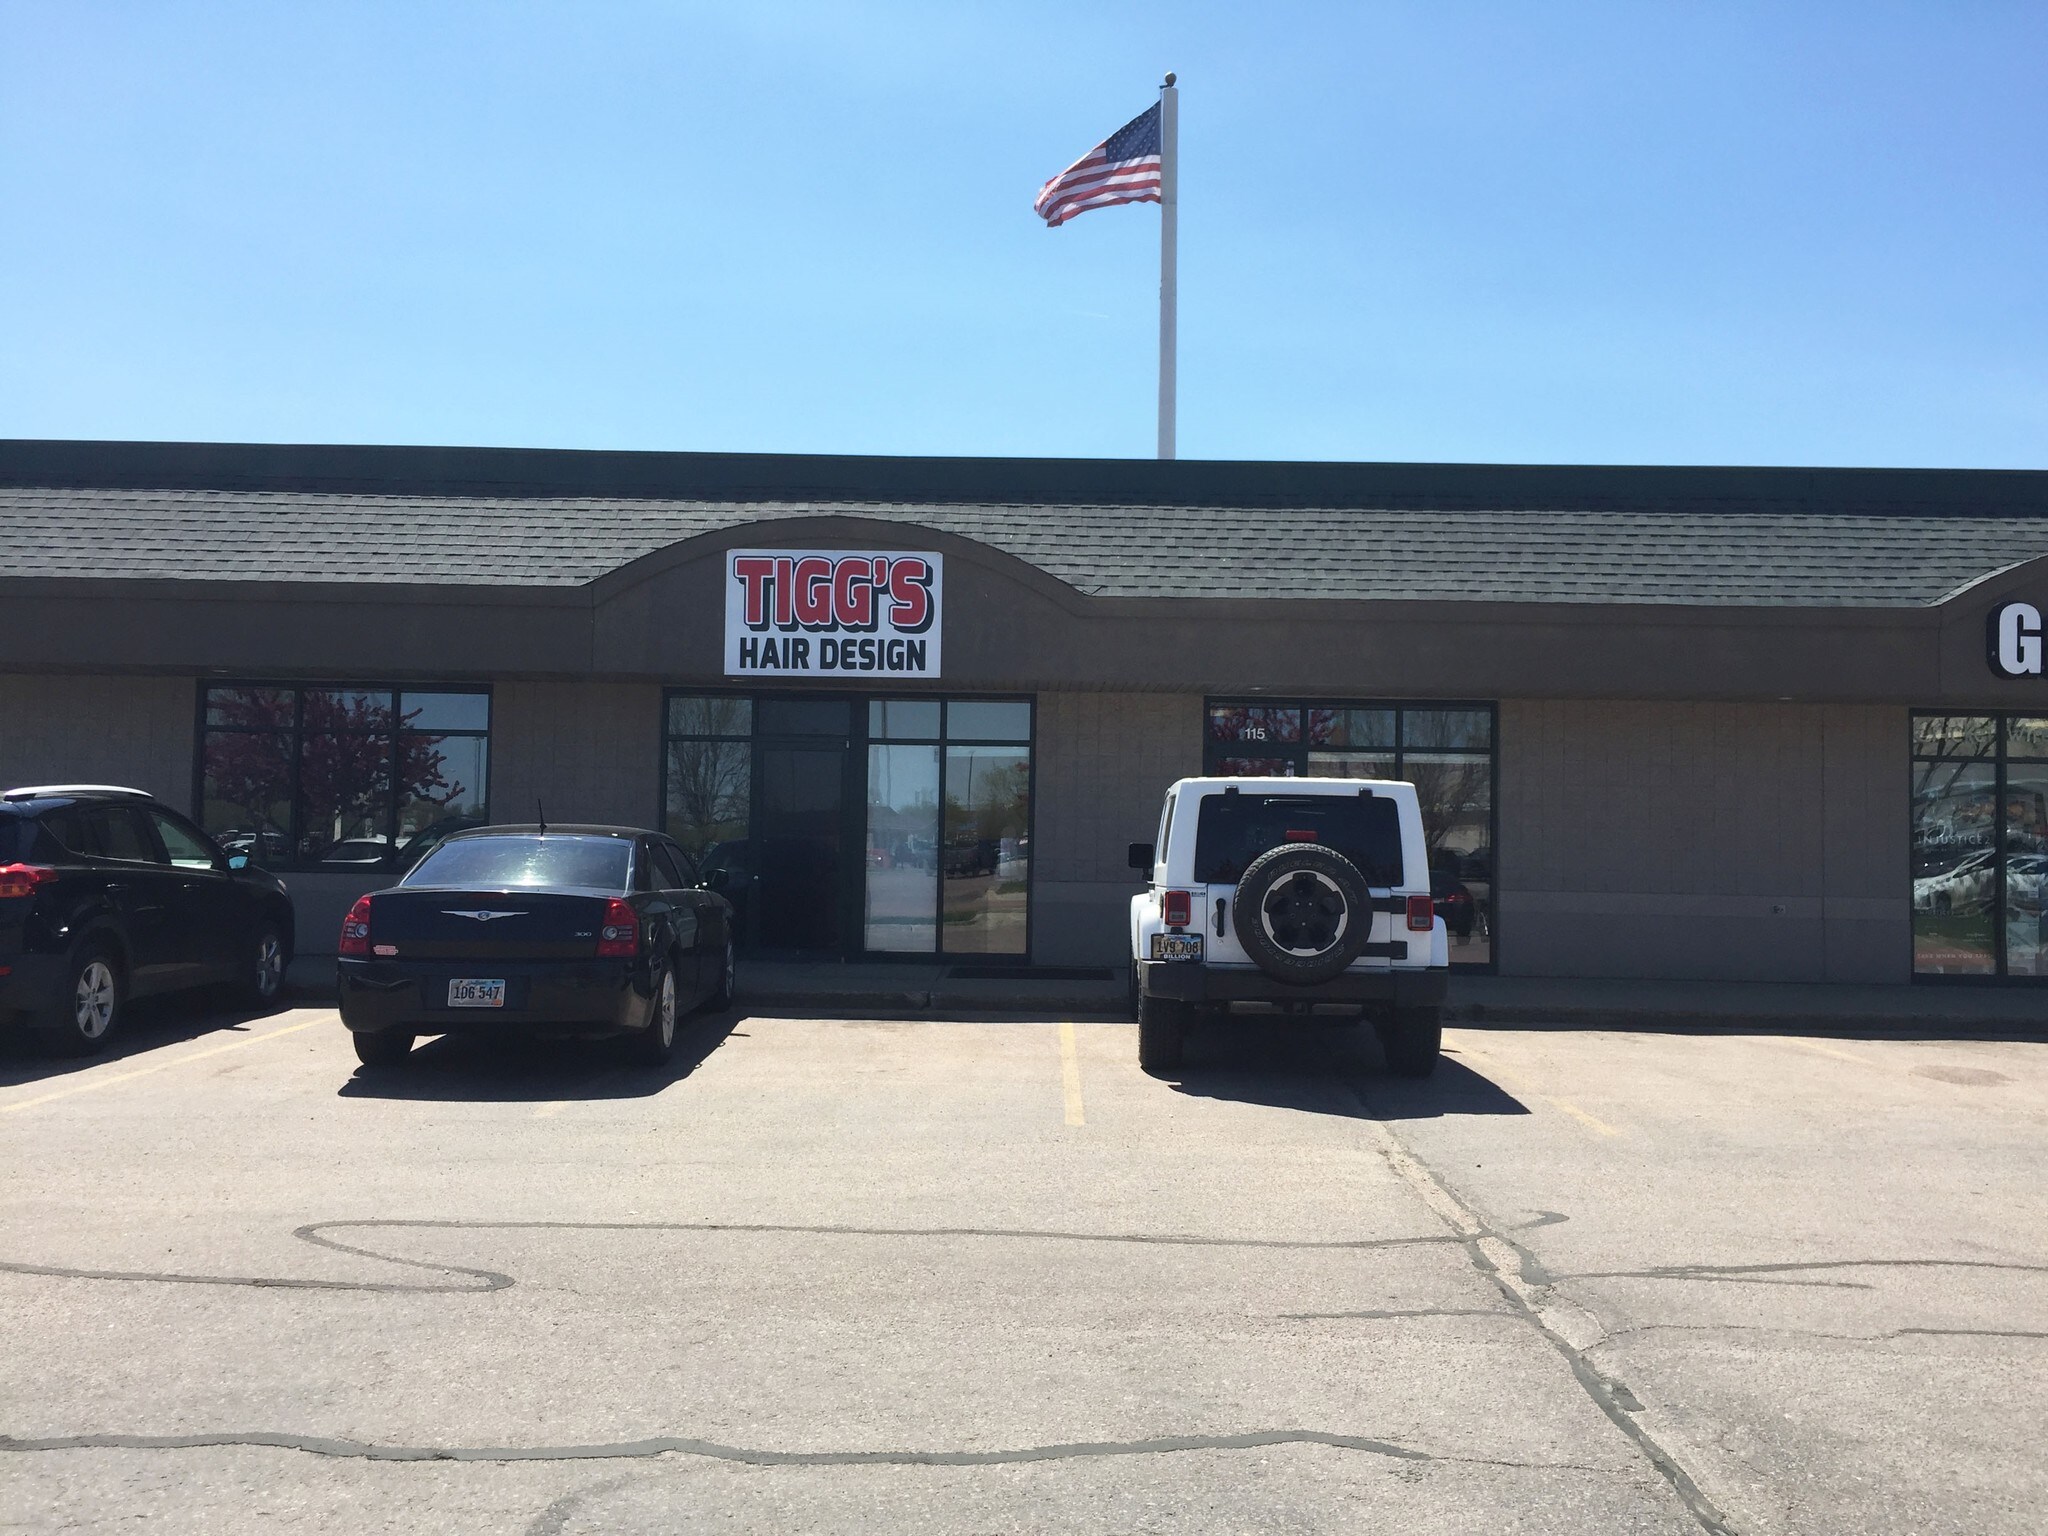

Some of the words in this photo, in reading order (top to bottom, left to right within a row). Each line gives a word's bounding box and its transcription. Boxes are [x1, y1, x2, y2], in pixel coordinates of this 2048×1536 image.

[735, 556, 934, 633] TIGG'S
[1998, 603, 2042, 675] G
[739, 637, 810, 669] HAIR
[819, 638, 926, 671] DESIGN
[1245, 727, 1265, 740] 115
[1918, 835, 1982, 845] INJUSTICE
[1180, 941, 1199, 954] 708
[478, 986, 501, 999] 547
